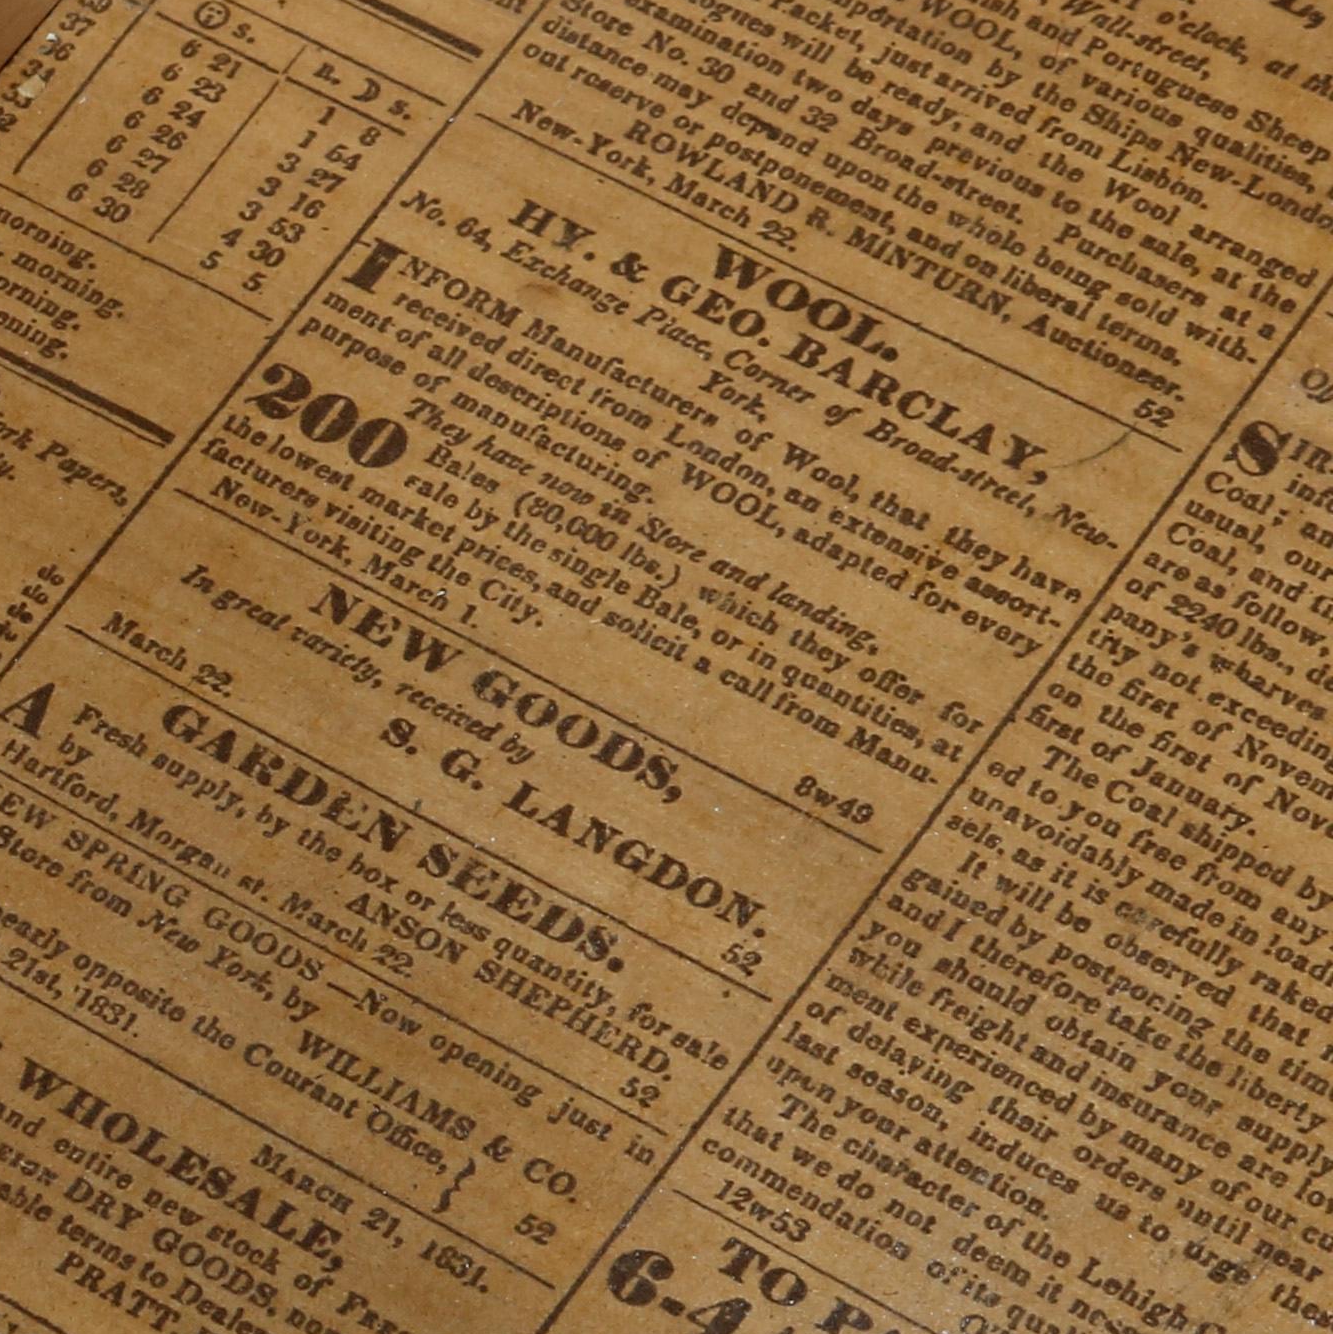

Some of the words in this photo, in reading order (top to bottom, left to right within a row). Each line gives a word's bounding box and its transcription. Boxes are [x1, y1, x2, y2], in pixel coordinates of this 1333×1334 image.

[659, 274, 770, 347] GEO.
[779, 332, 1049, 486] BARCLAY,
[713, 241, 899, 363] WOOL.
[242, 361, 409, 468] 200
[307, 581, 465, 673] NEW
[470, 669, 683, 805] GOODS,
[160, 703, 413, 853] GARDEN
[415, 842, 625, 974] SEEDS.
[500, 779, 767, 939] LANGDON.
[18, 1055, 344, 1274] WHOLESALE,
[716, 1235, 809, 1307] TO
